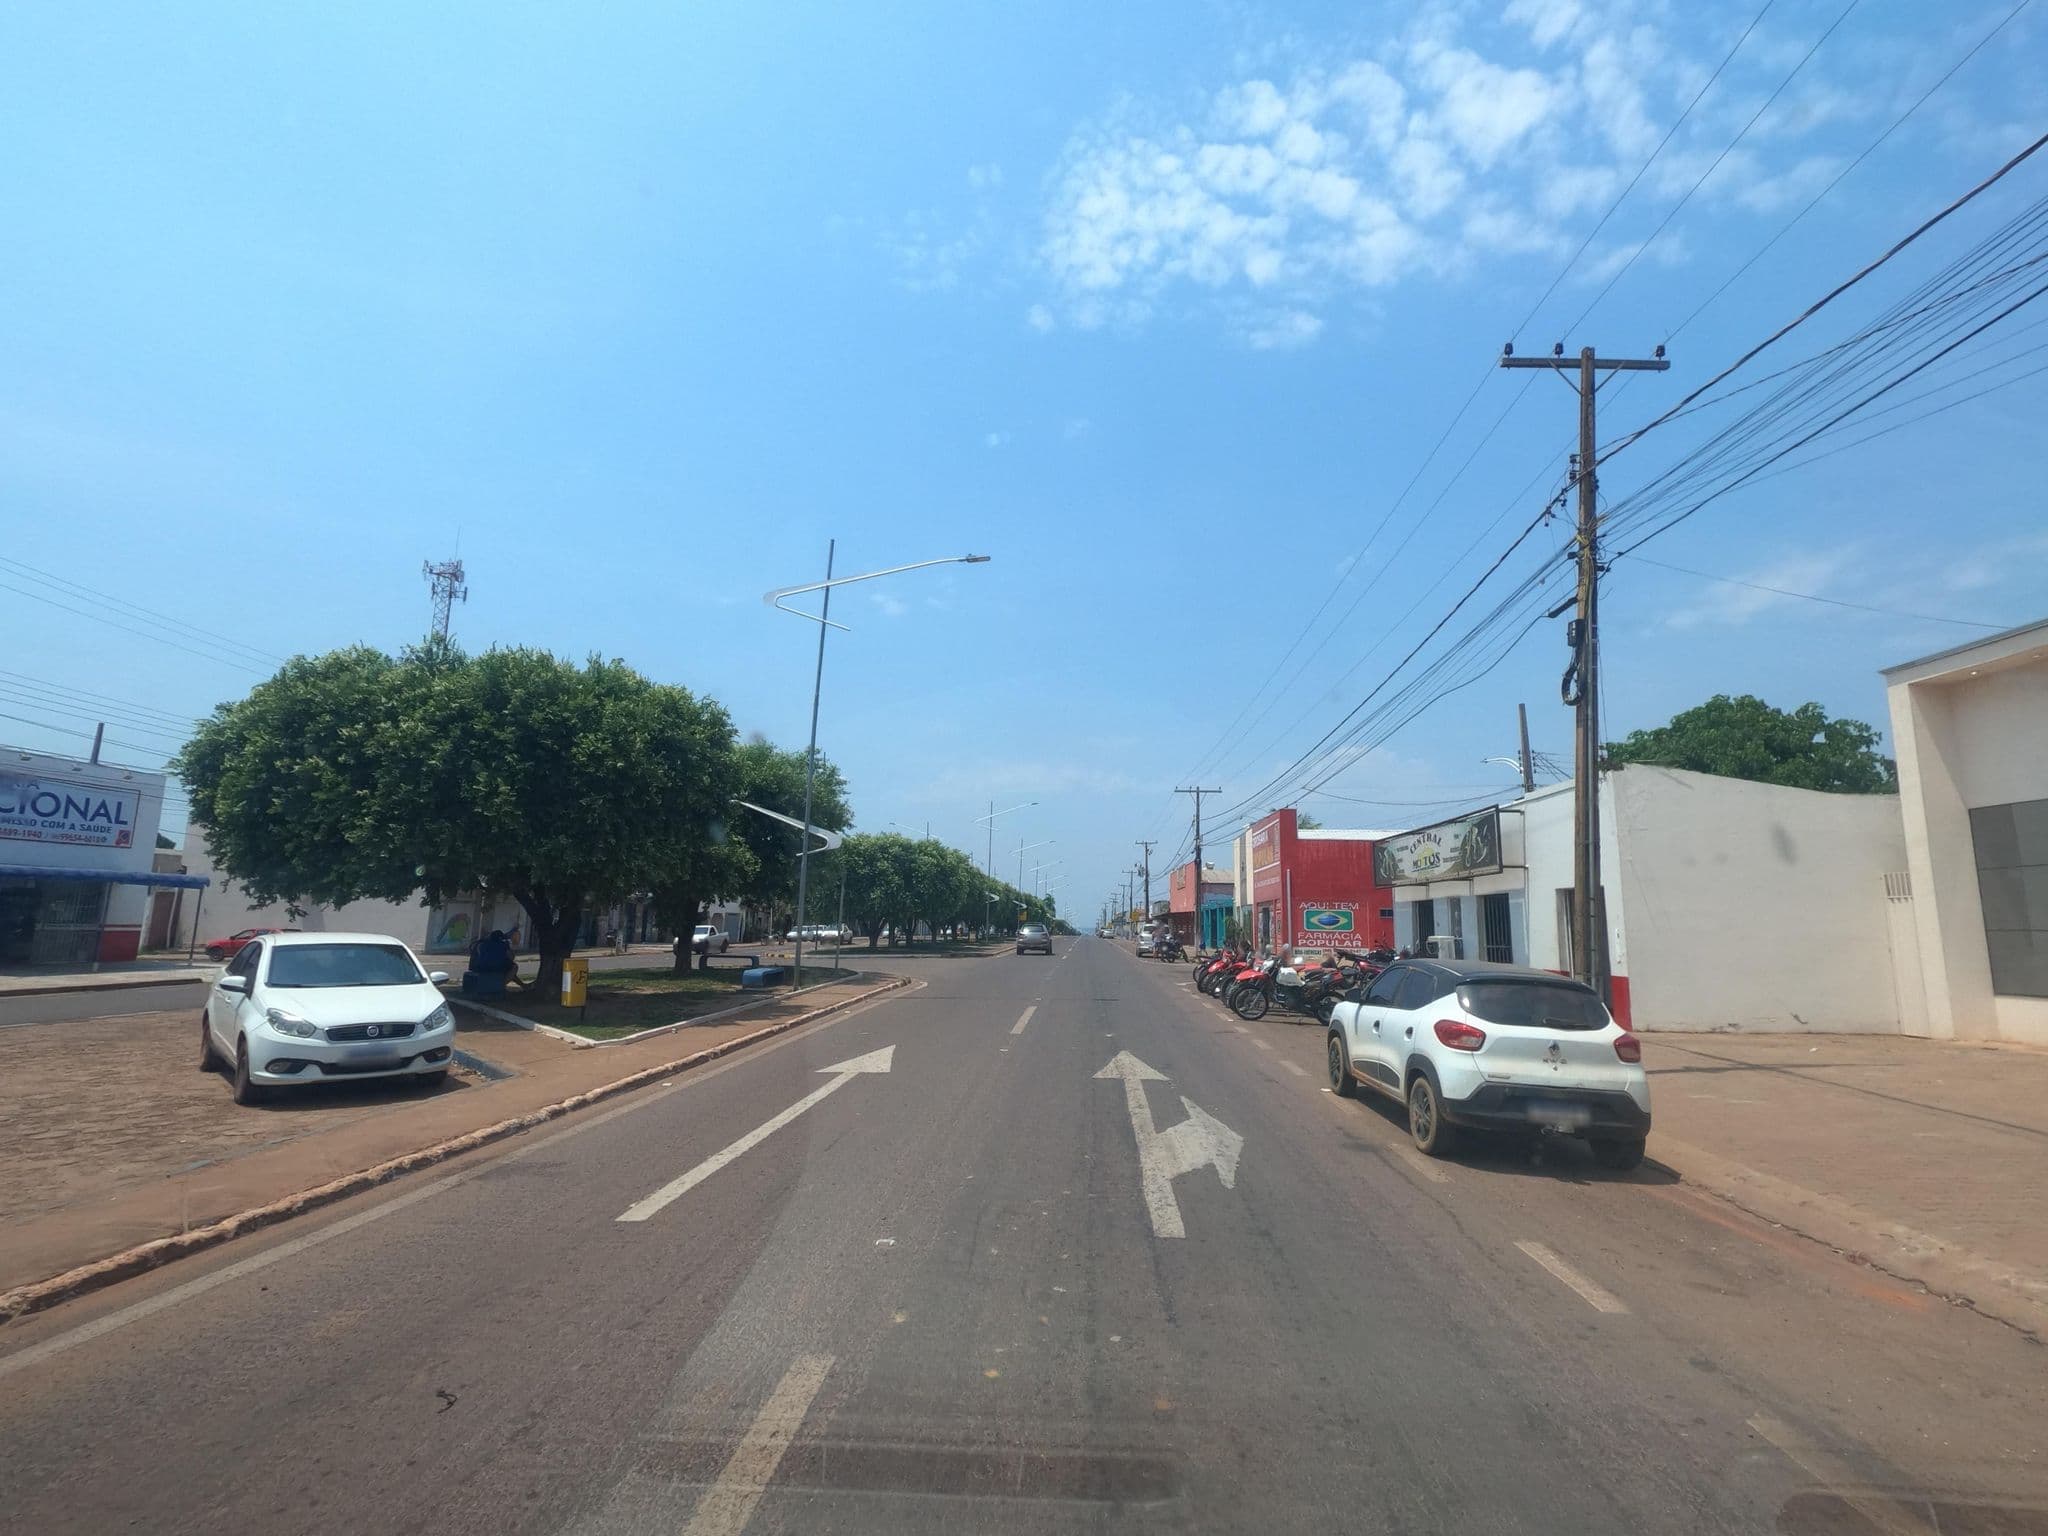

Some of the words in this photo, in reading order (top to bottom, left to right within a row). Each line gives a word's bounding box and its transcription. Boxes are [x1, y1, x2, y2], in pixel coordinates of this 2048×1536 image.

[41, 820, 65, 830] COM
[69, 823, 76, 831] A
[1410, 832, 1441, 854] CENTRAL
[1333, 902, 1359, 910] TEM
